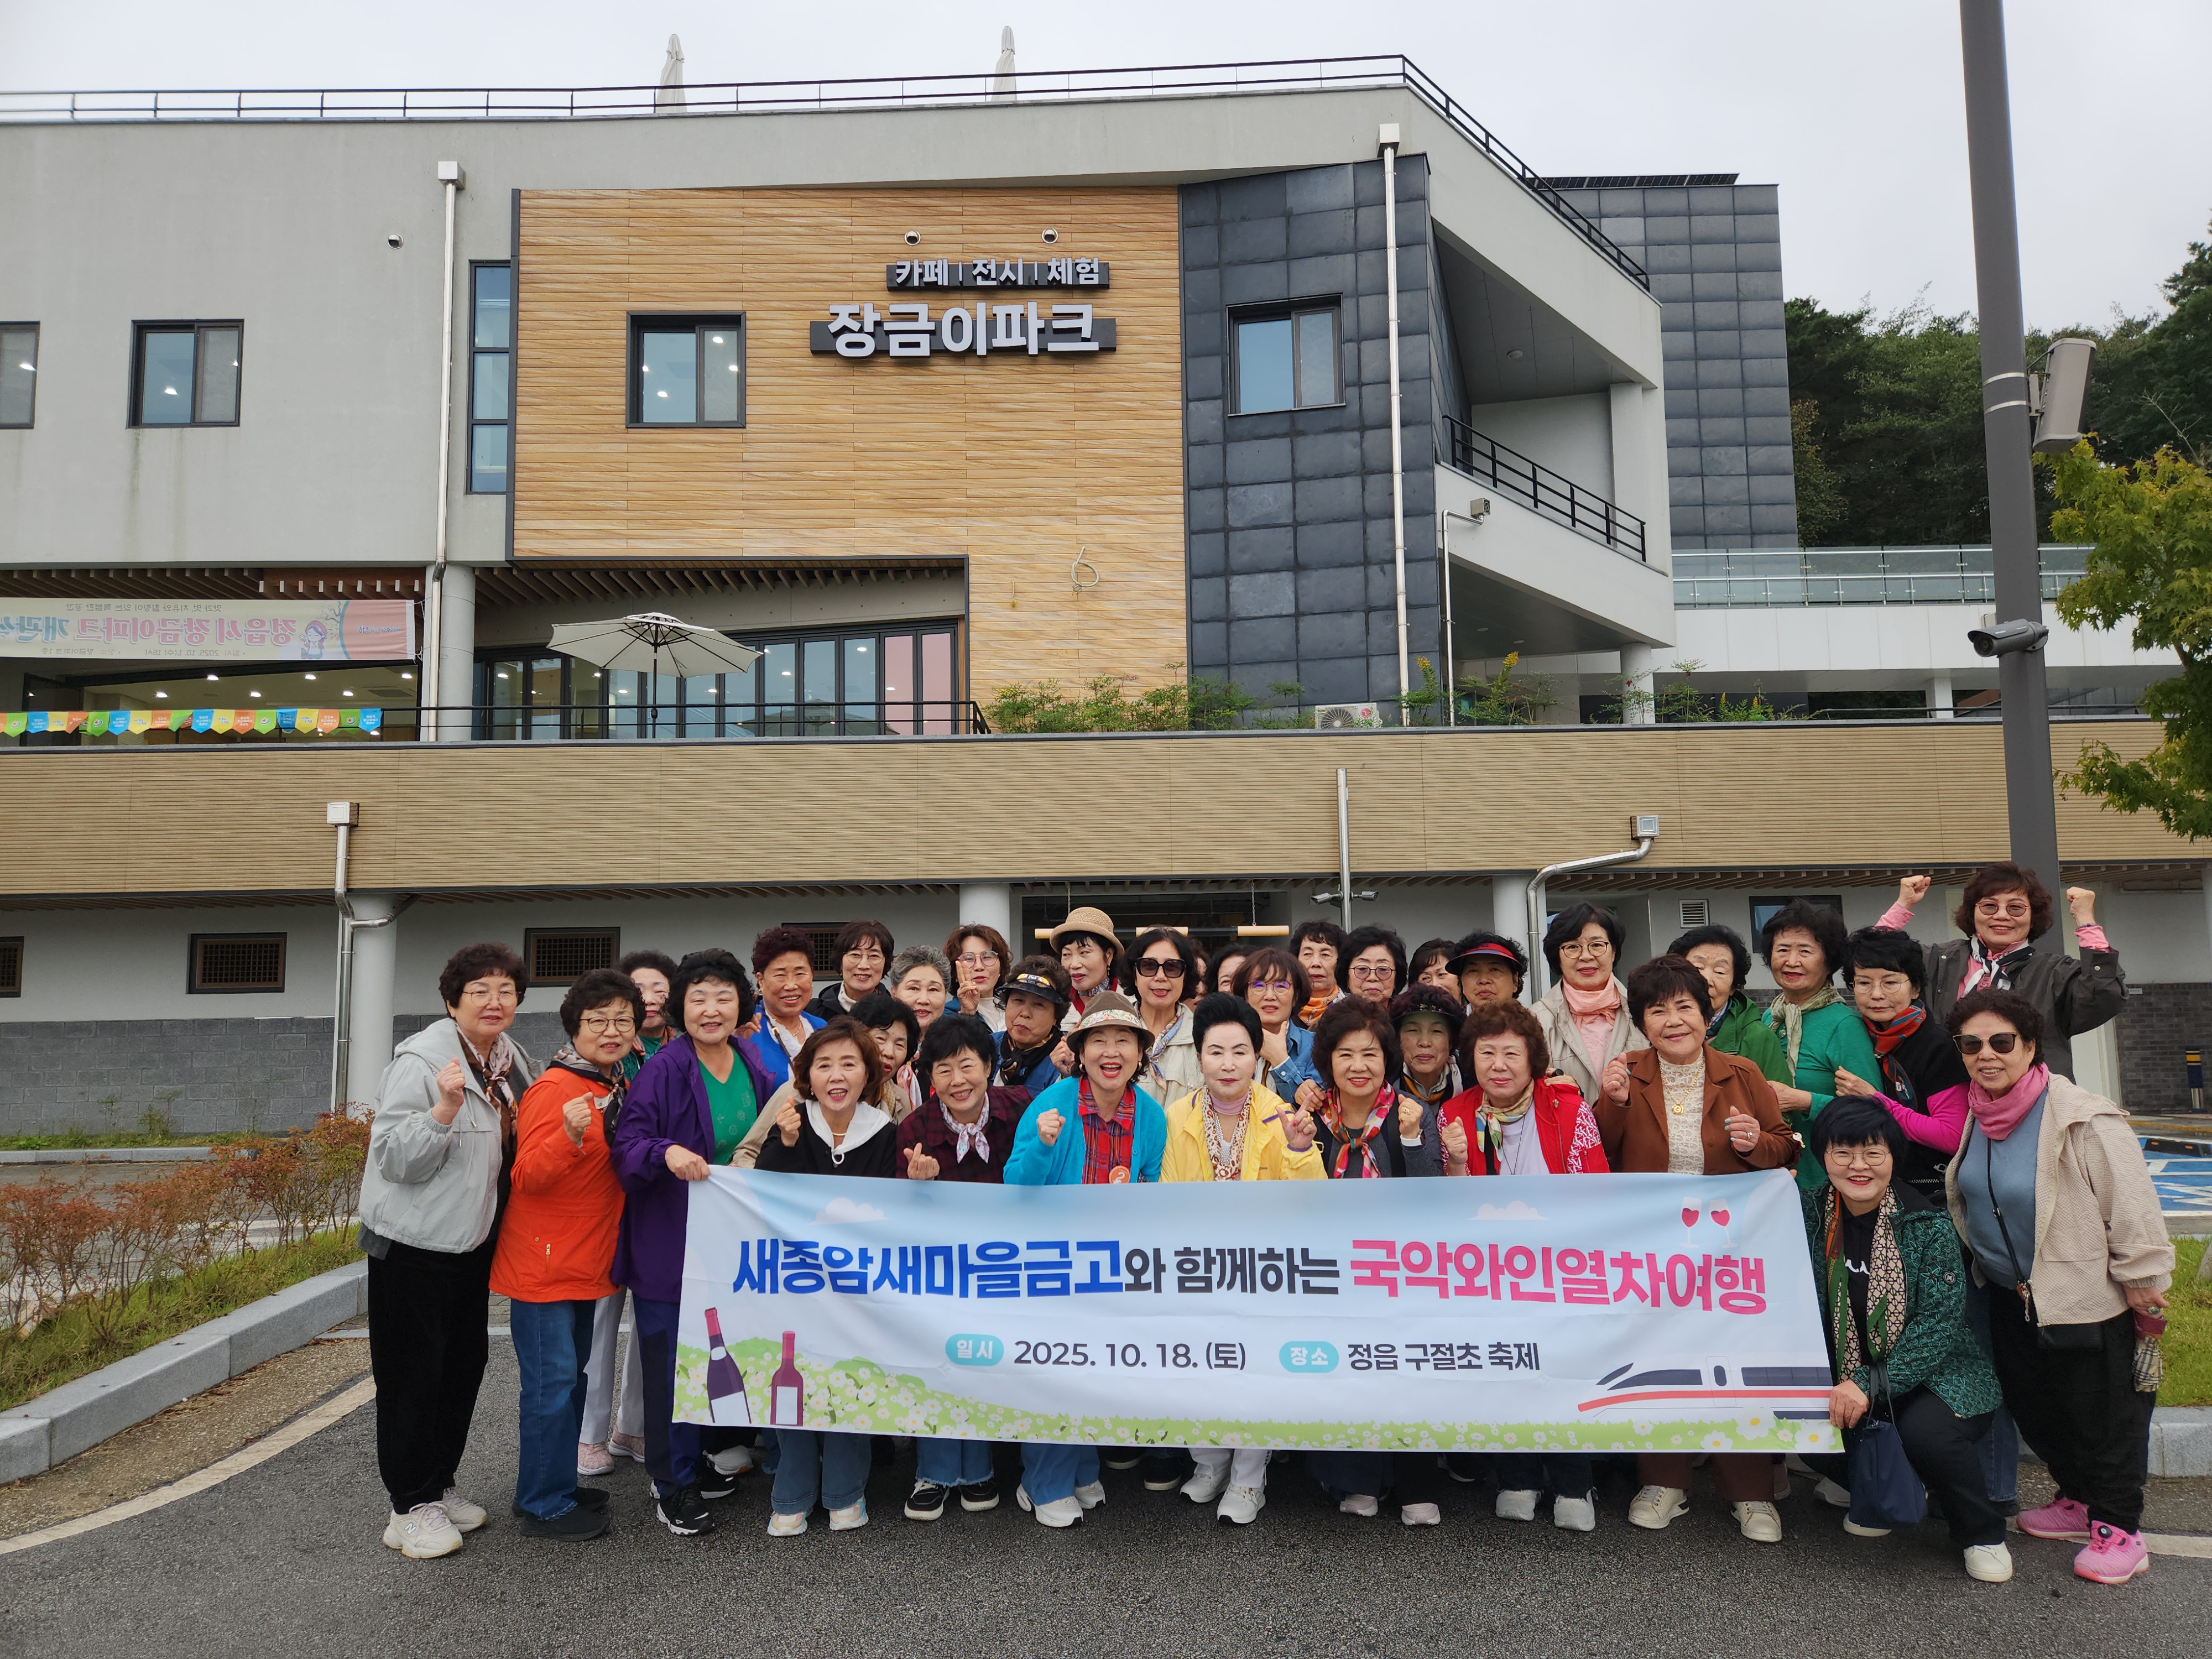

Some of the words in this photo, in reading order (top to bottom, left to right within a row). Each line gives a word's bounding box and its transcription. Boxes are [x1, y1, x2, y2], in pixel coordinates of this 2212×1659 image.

[895, 258, 949, 286] 카페
[972, 257, 1024, 286] 전시
[1047, 257, 1099, 285] 체험
[827, 301, 1099, 358] 장금이파크
[733, 1238, 1166, 1298] 새종암새마을금고와
[1175, 1246, 1340, 1295] 함께하는
[1350, 1239, 1767, 1314] 국악와인열차여행
[956, 1339, 993, 1359] 일시
[1014, 1340, 1095, 1366] 2025.
[1106, 1344, 1147, 1368] 10.
[1157, 1343, 1198, 1368] 18.
[1206, 1342, 1246, 1371] (토)
[1290, 1347, 1328, 1366] 장소
[1348, 1344, 1398, 1371] 정읍
[1405, 1343, 1483, 1371] 구절초
[1488, 1342, 1541, 1371] 축제
